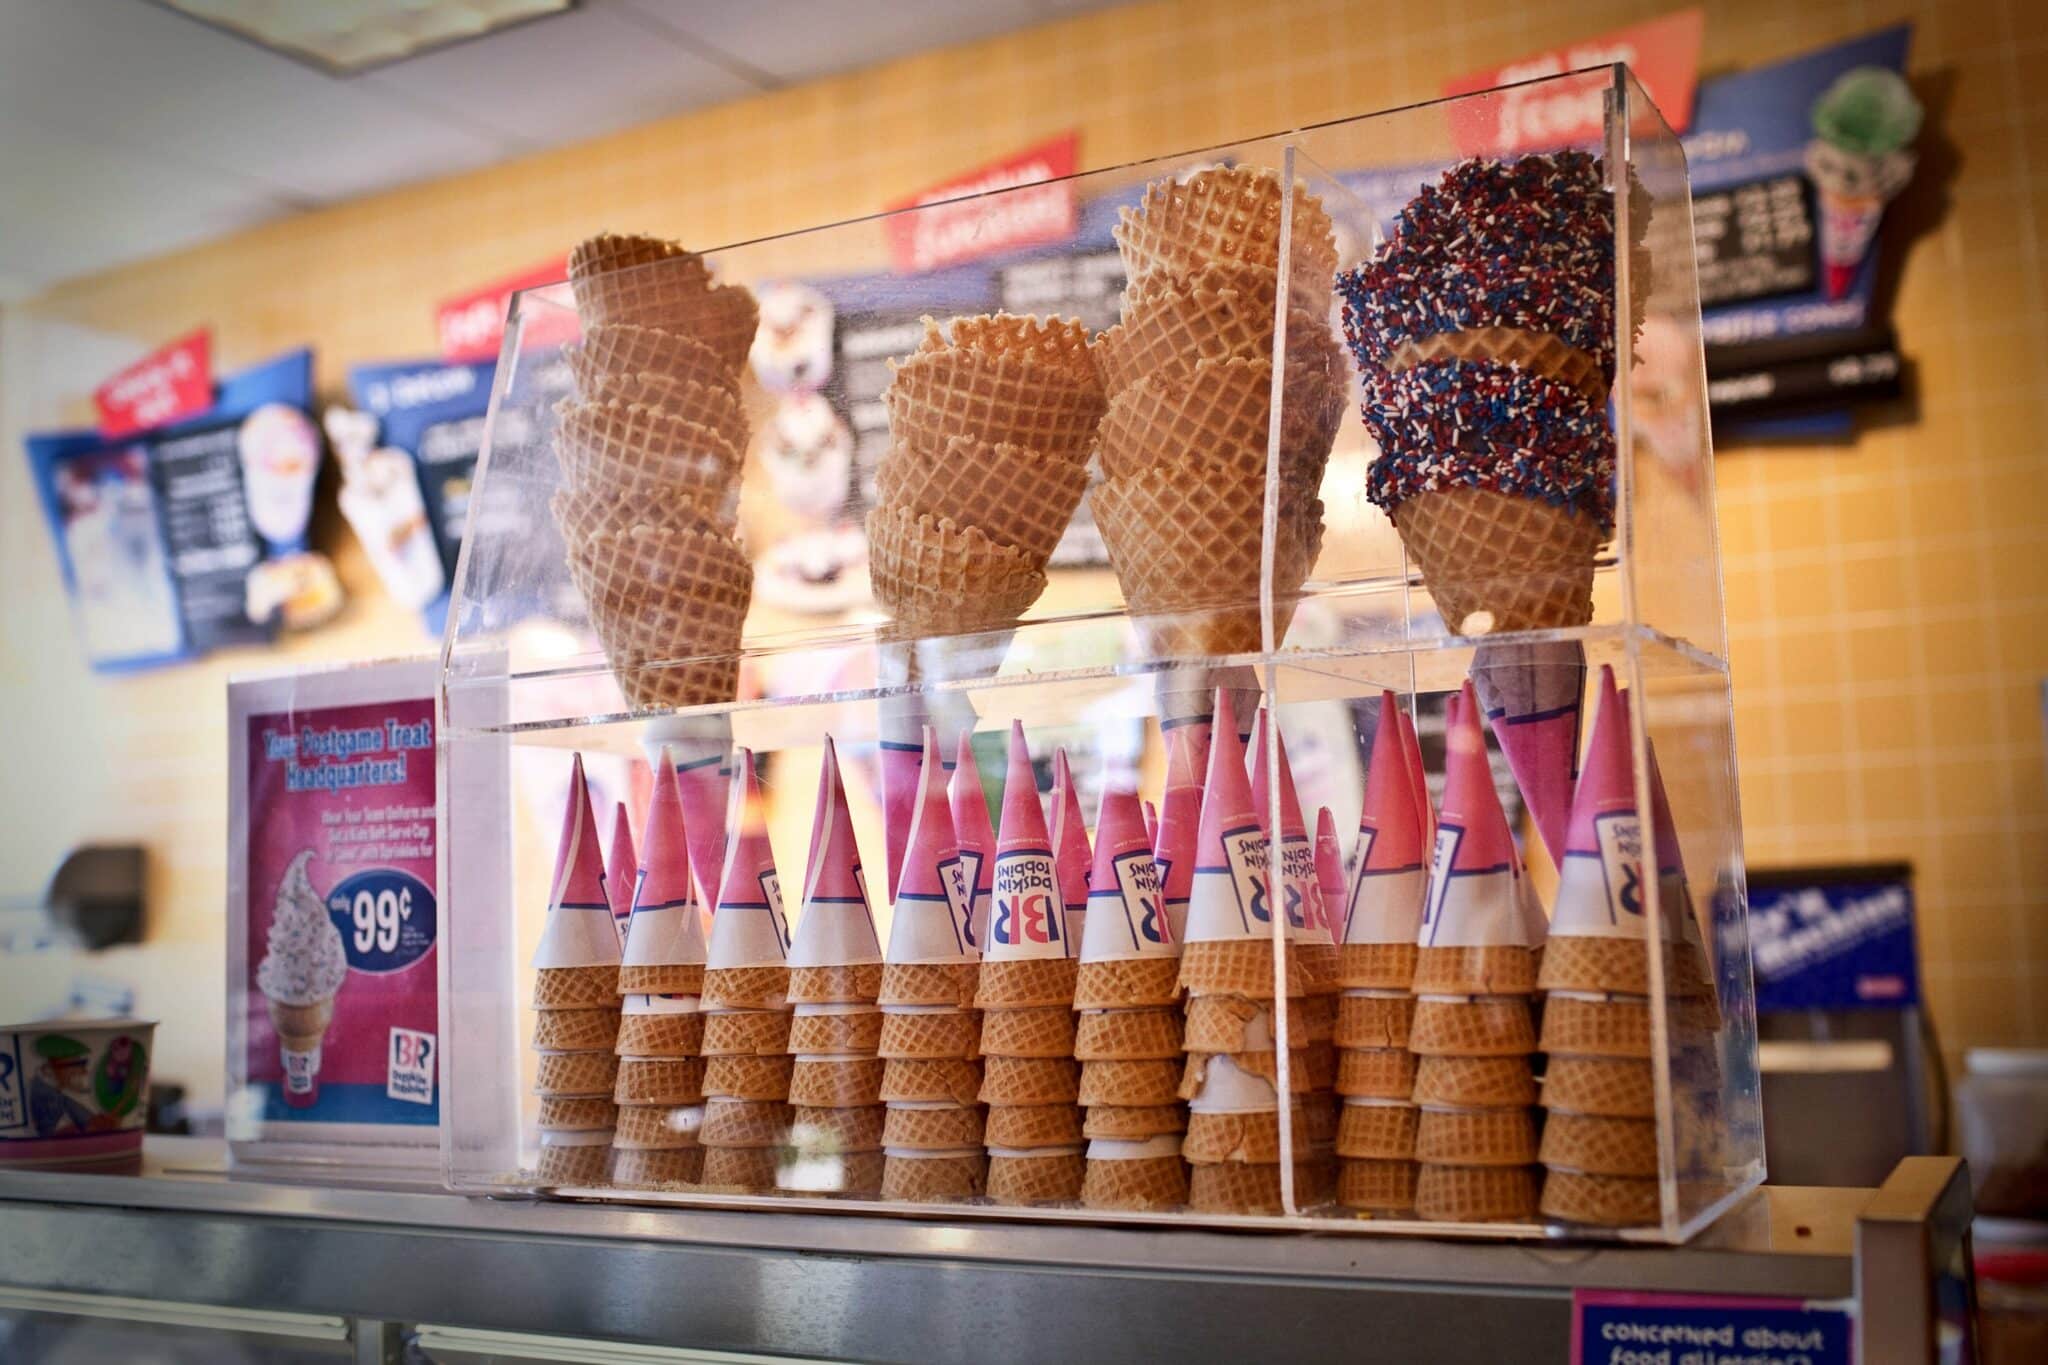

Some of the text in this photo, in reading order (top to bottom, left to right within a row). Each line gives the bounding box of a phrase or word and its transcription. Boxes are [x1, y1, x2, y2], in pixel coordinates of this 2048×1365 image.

[302, 726, 384, 759] Postgame
[386, 718, 432, 750] Treat
[285, 752, 407, 796] Headquarters!
[998, 876, 1053, 894] baskin
[994, 894, 1061, 945] BR
[395, 1034, 431, 1069] BR
[1601, 1322, 1825, 1351] concerned about
